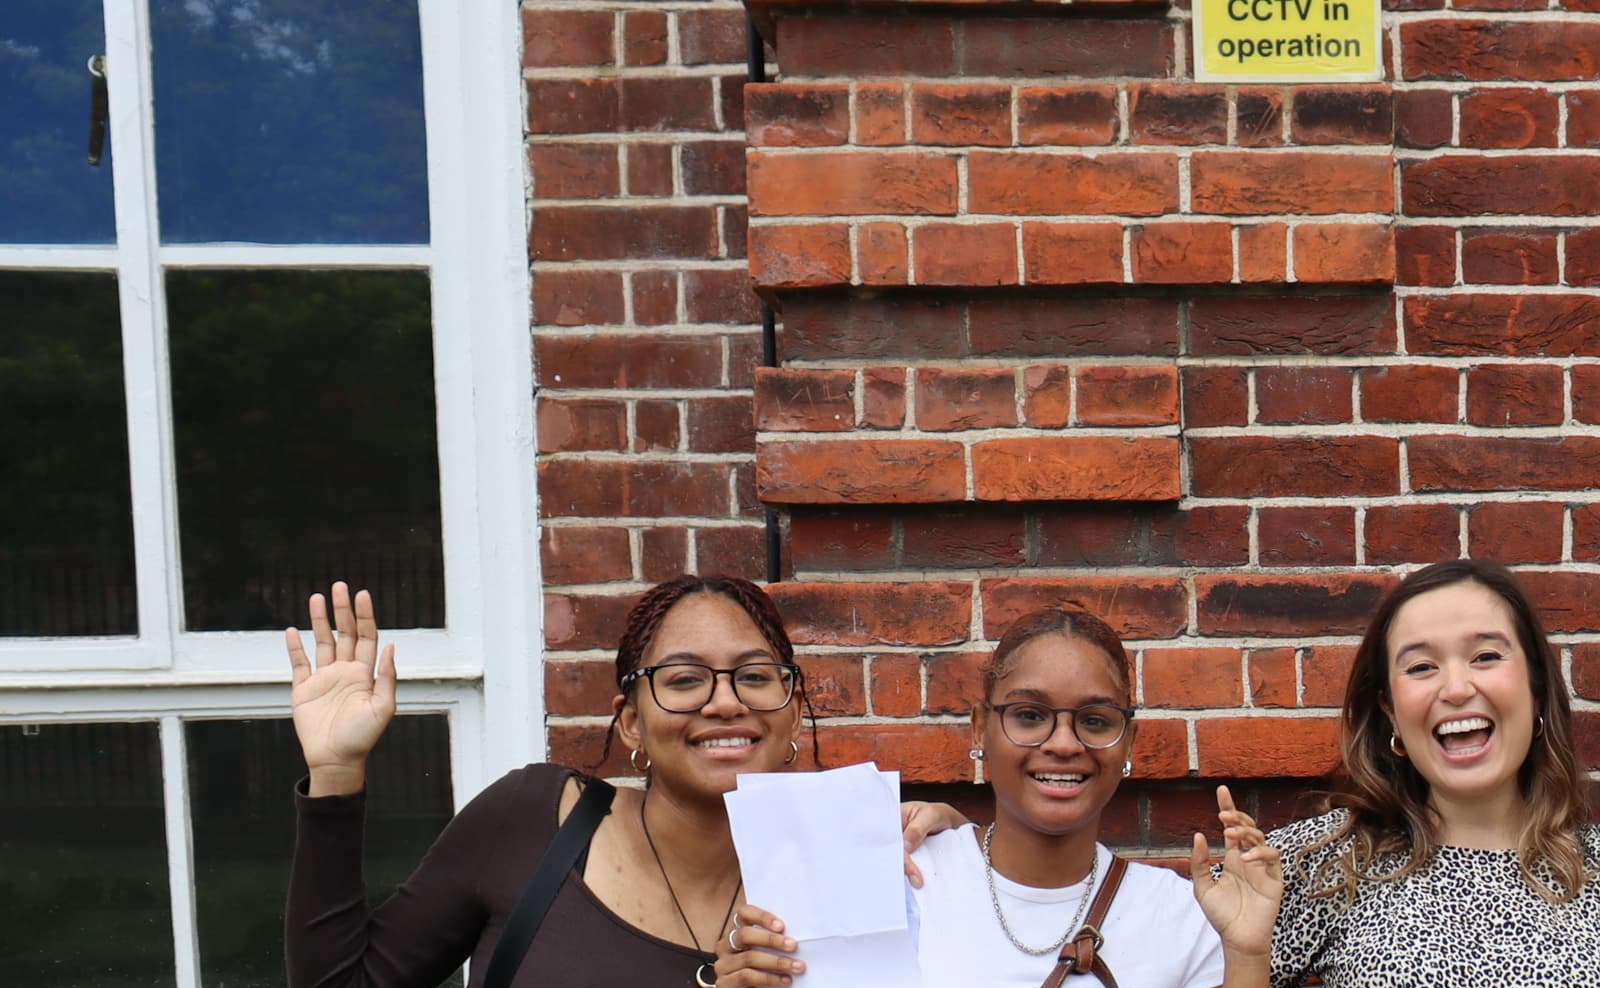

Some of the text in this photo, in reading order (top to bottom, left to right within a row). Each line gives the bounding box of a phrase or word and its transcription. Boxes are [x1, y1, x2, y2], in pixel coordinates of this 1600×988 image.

[1227, 0, 1349, 21] CCTV in
[1217, 33, 1361, 63] operation
